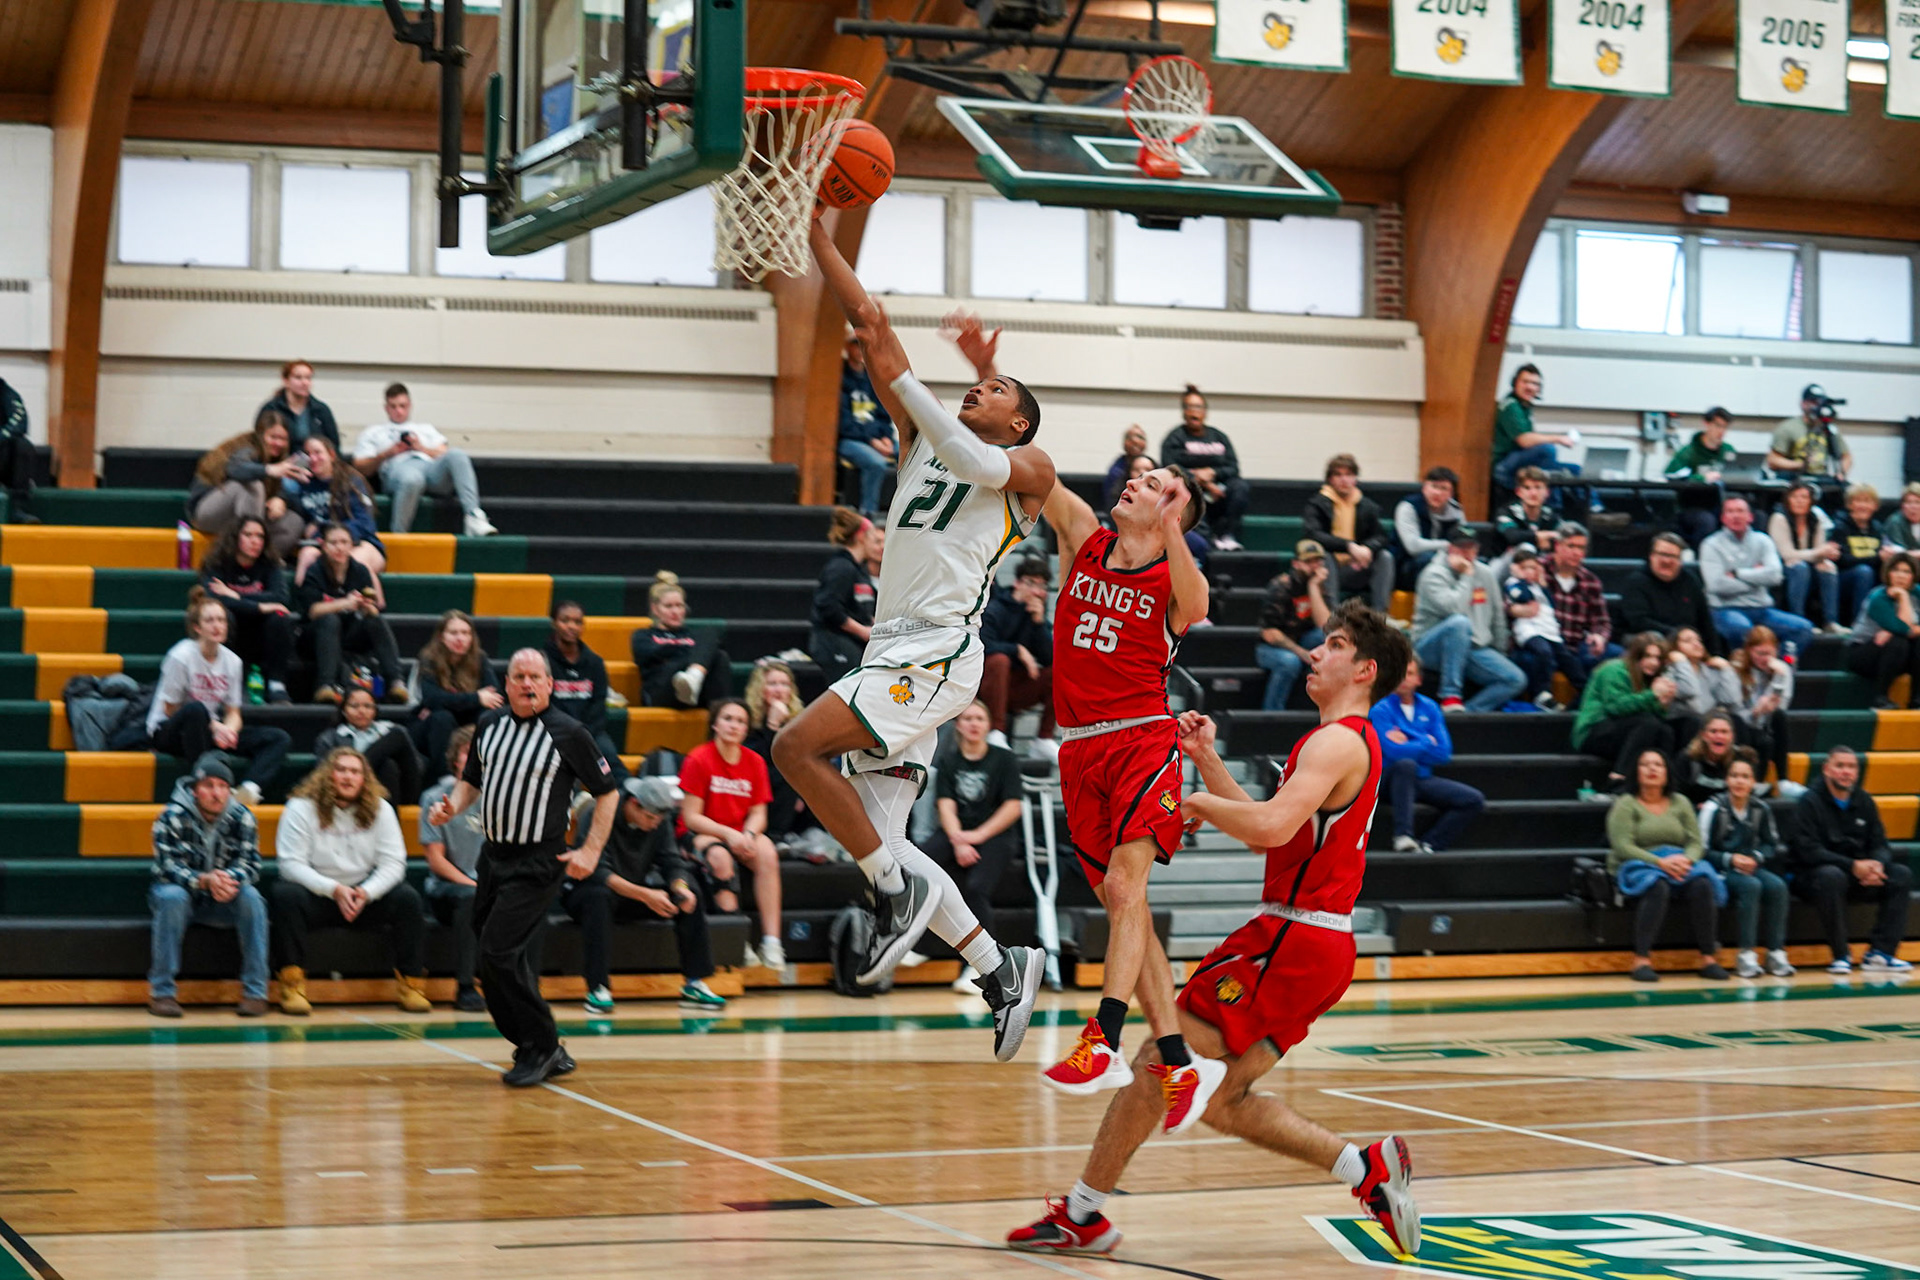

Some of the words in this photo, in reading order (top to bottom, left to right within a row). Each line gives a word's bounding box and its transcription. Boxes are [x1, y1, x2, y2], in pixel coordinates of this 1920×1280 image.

[1416, 0, 1488, 17] 2004
[1578, 0, 1644, 30] 2004
[1760, 16, 1826, 49] 2005
[895, 476, 974, 533] 21
[1069, 571, 1156, 620] KING'S
[1072, 610, 1124, 654] 25
